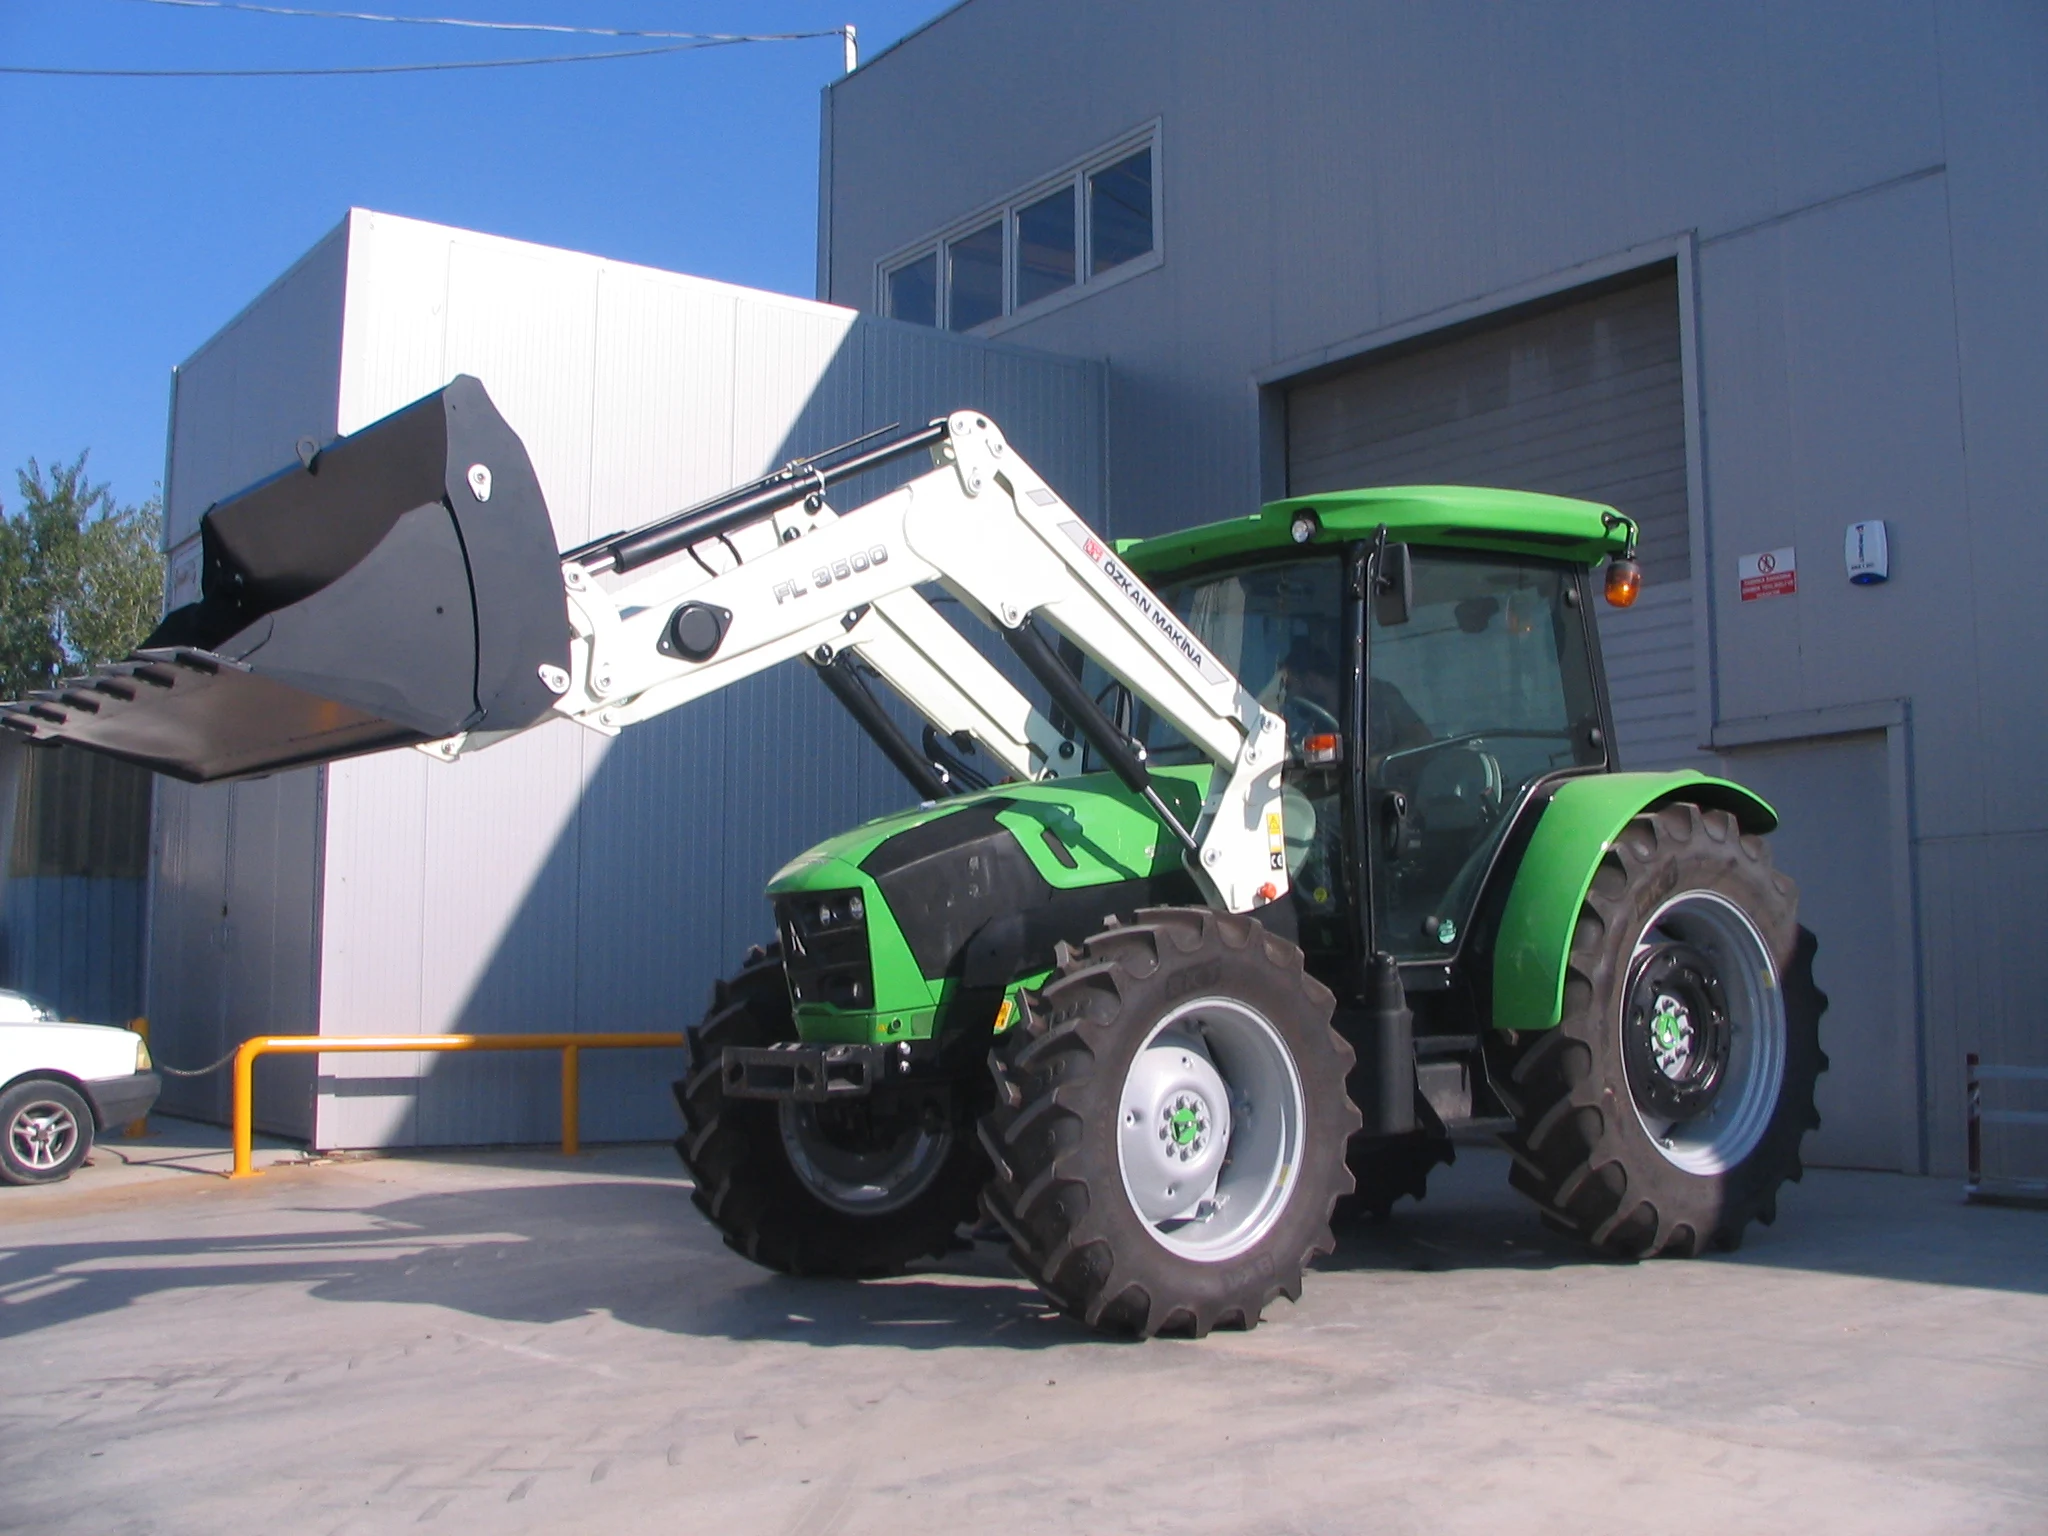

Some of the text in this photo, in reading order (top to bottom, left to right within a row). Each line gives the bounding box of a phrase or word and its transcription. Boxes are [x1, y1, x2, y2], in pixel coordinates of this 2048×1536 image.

[773, 544, 888, 605] FL 3500
[1104, 561, 1201, 667] ÖZKAN MAKİNA
